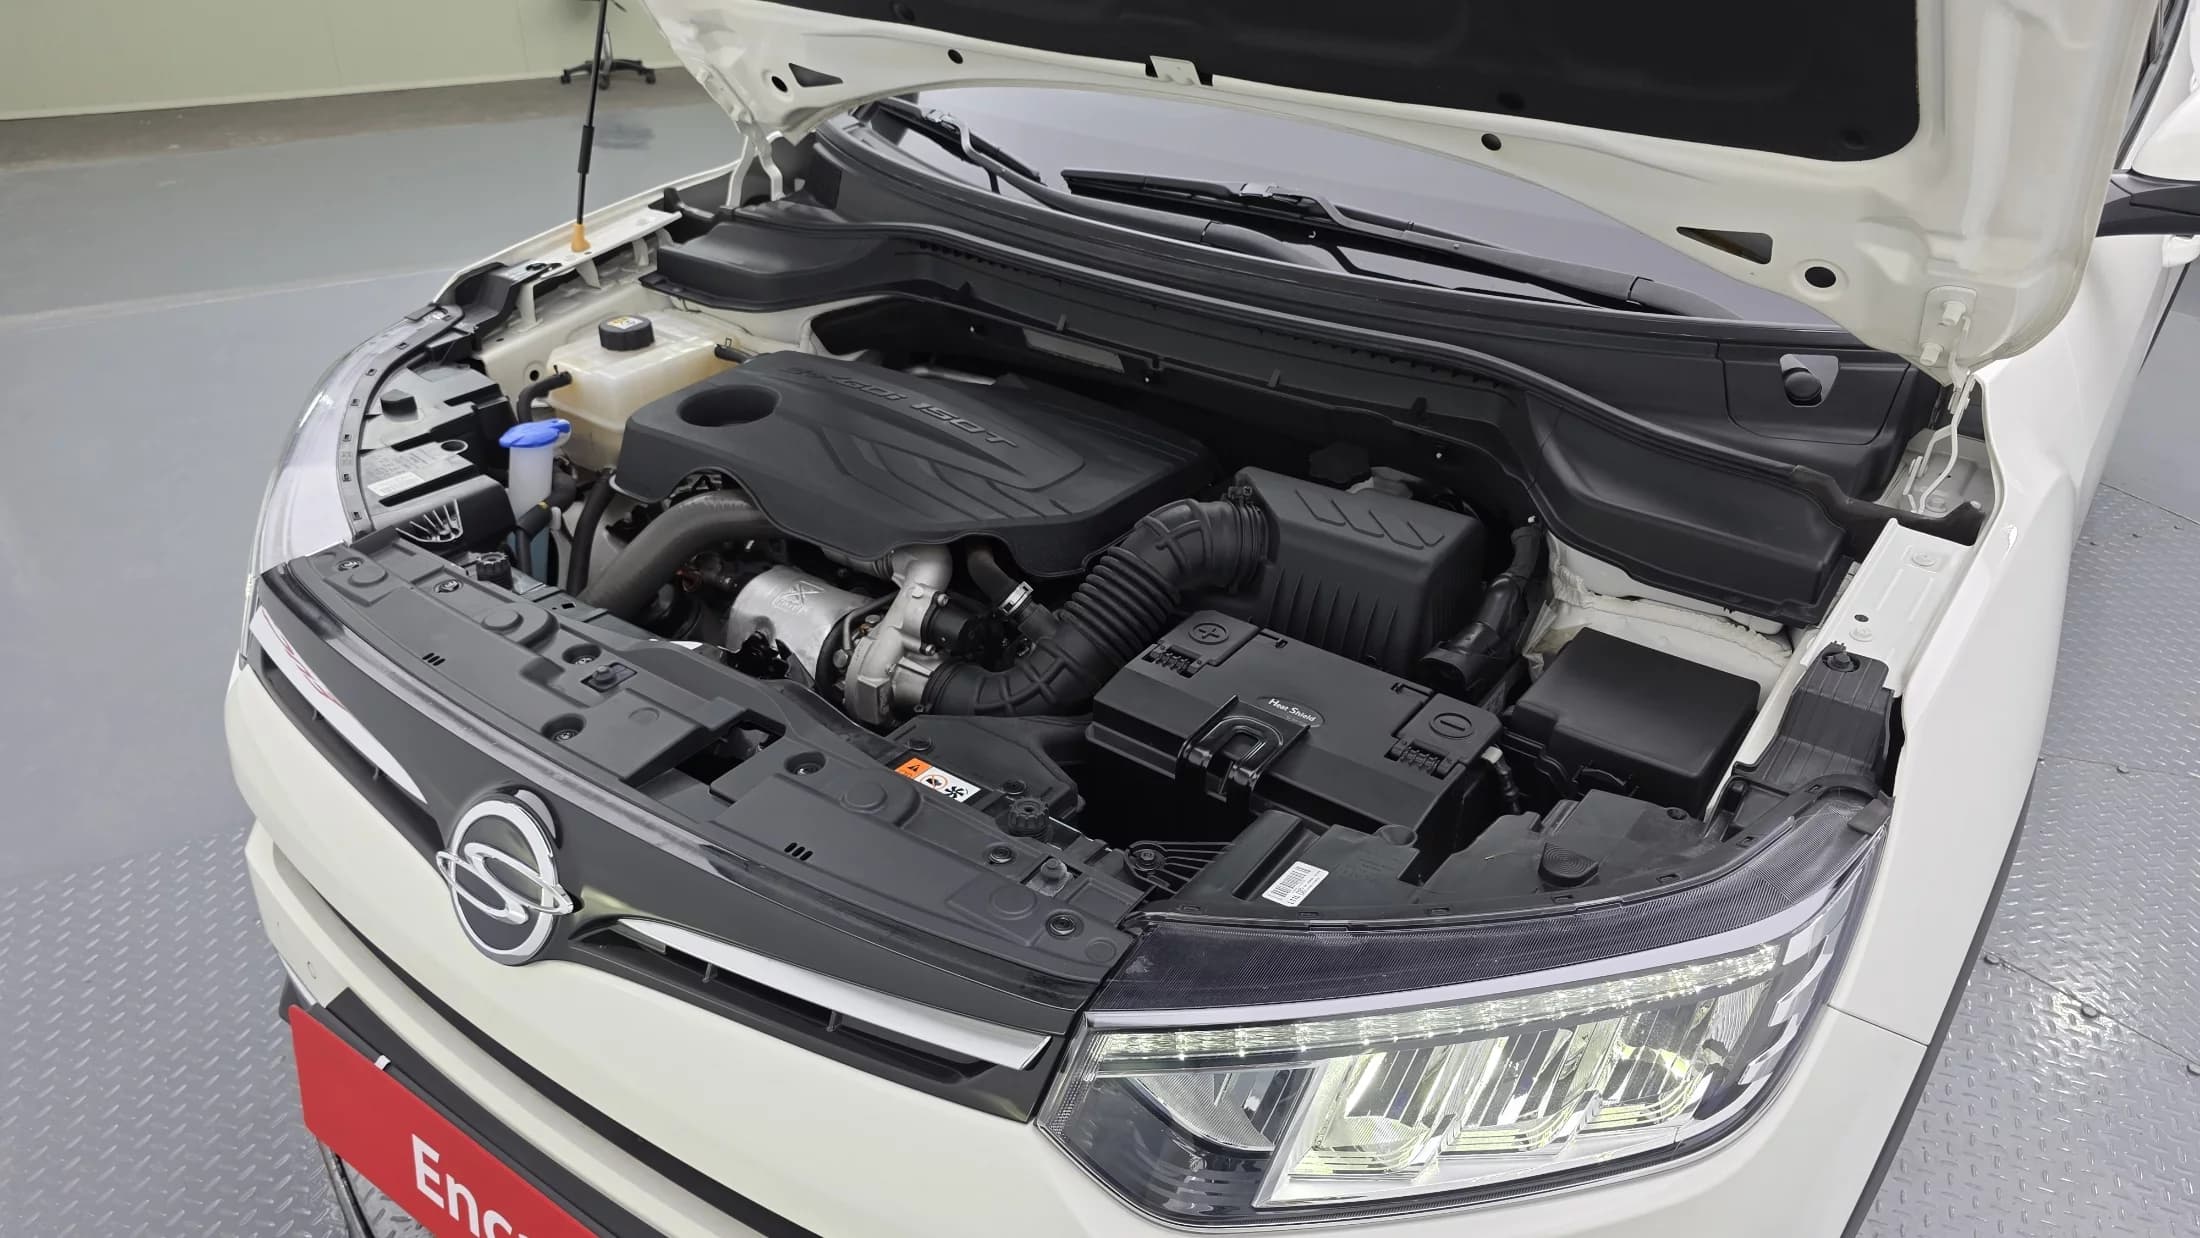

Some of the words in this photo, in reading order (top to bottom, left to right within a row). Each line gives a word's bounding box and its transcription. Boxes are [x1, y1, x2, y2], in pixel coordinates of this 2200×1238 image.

[1268, 698, 1289, 712] Heat
[1289, 707, 1317, 722] Shield
[411, 1133, 529, 1238] Enc
